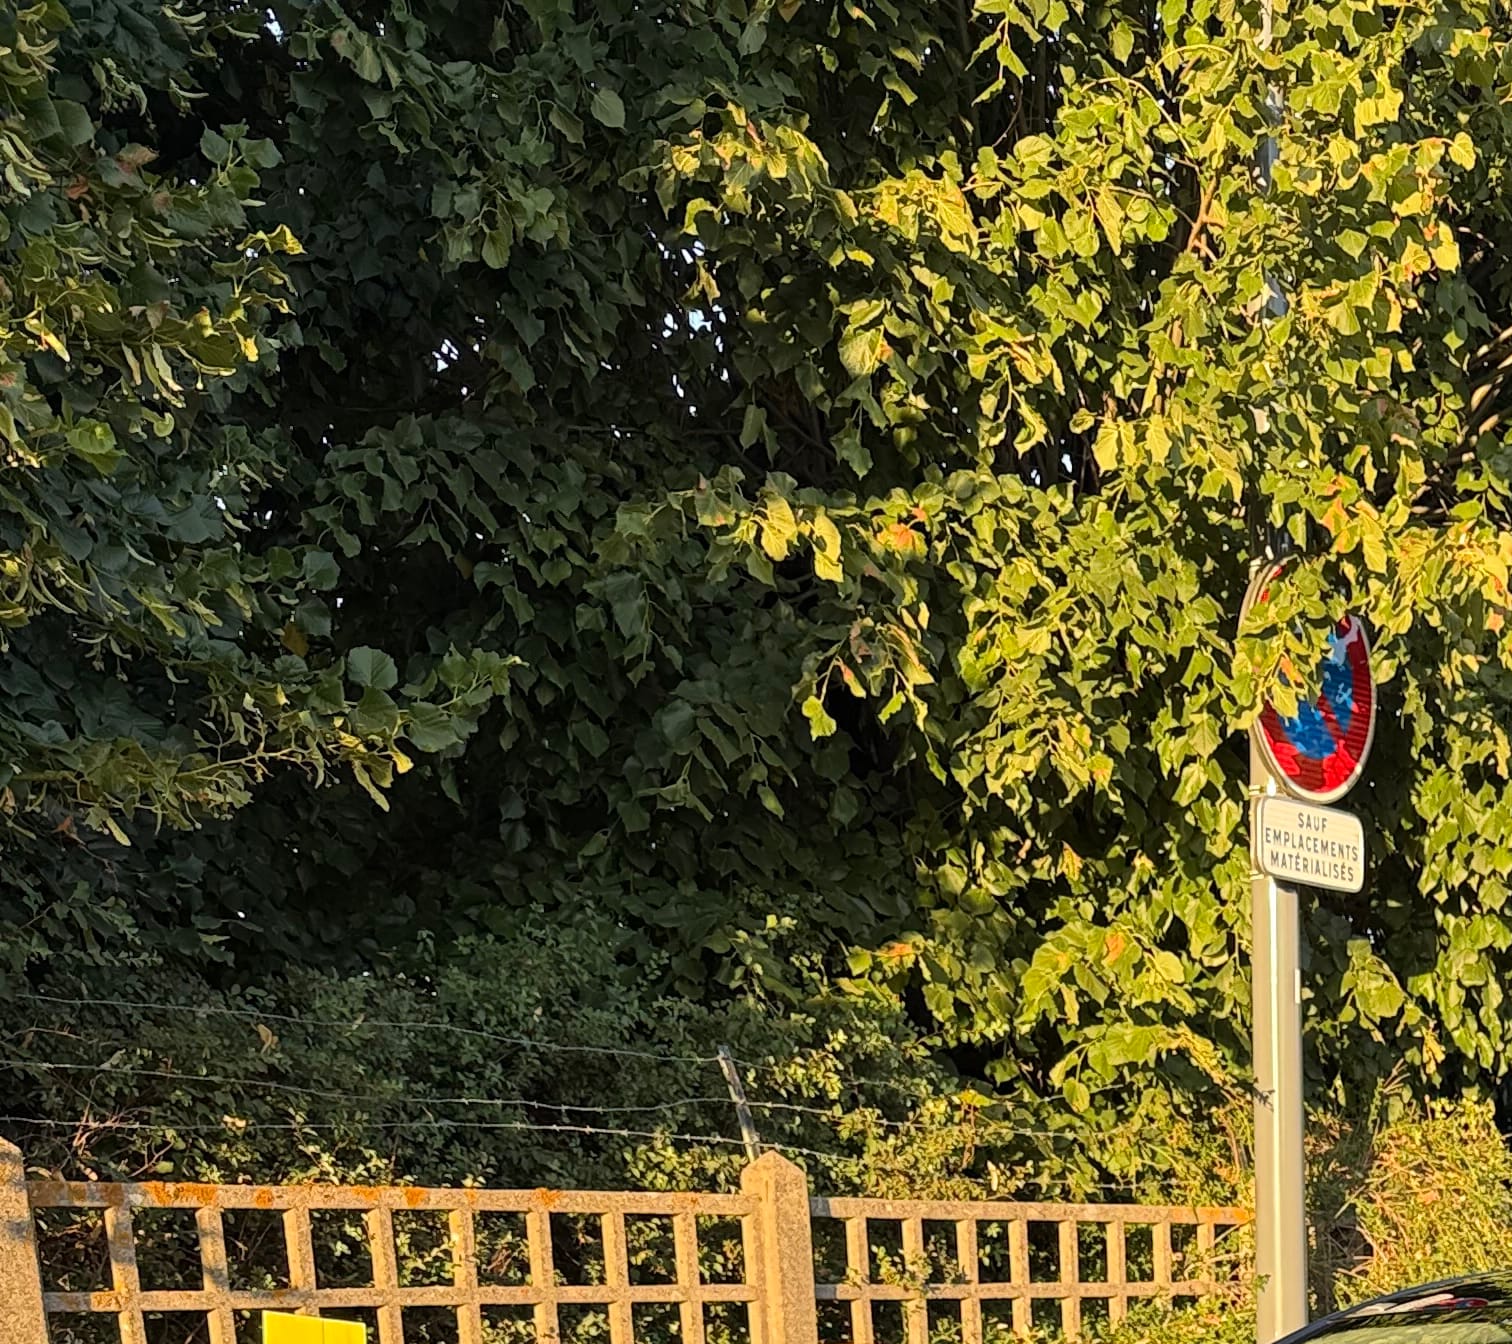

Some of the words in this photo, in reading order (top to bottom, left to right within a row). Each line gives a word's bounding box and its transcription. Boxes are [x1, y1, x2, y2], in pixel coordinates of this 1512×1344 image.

[1298, 812, 1328, 832] SAUF
[1265, 827, 1358, 862] EMPLACEMENTS
[1270, 850, 1354, 882] MATÉRIALISÉS
